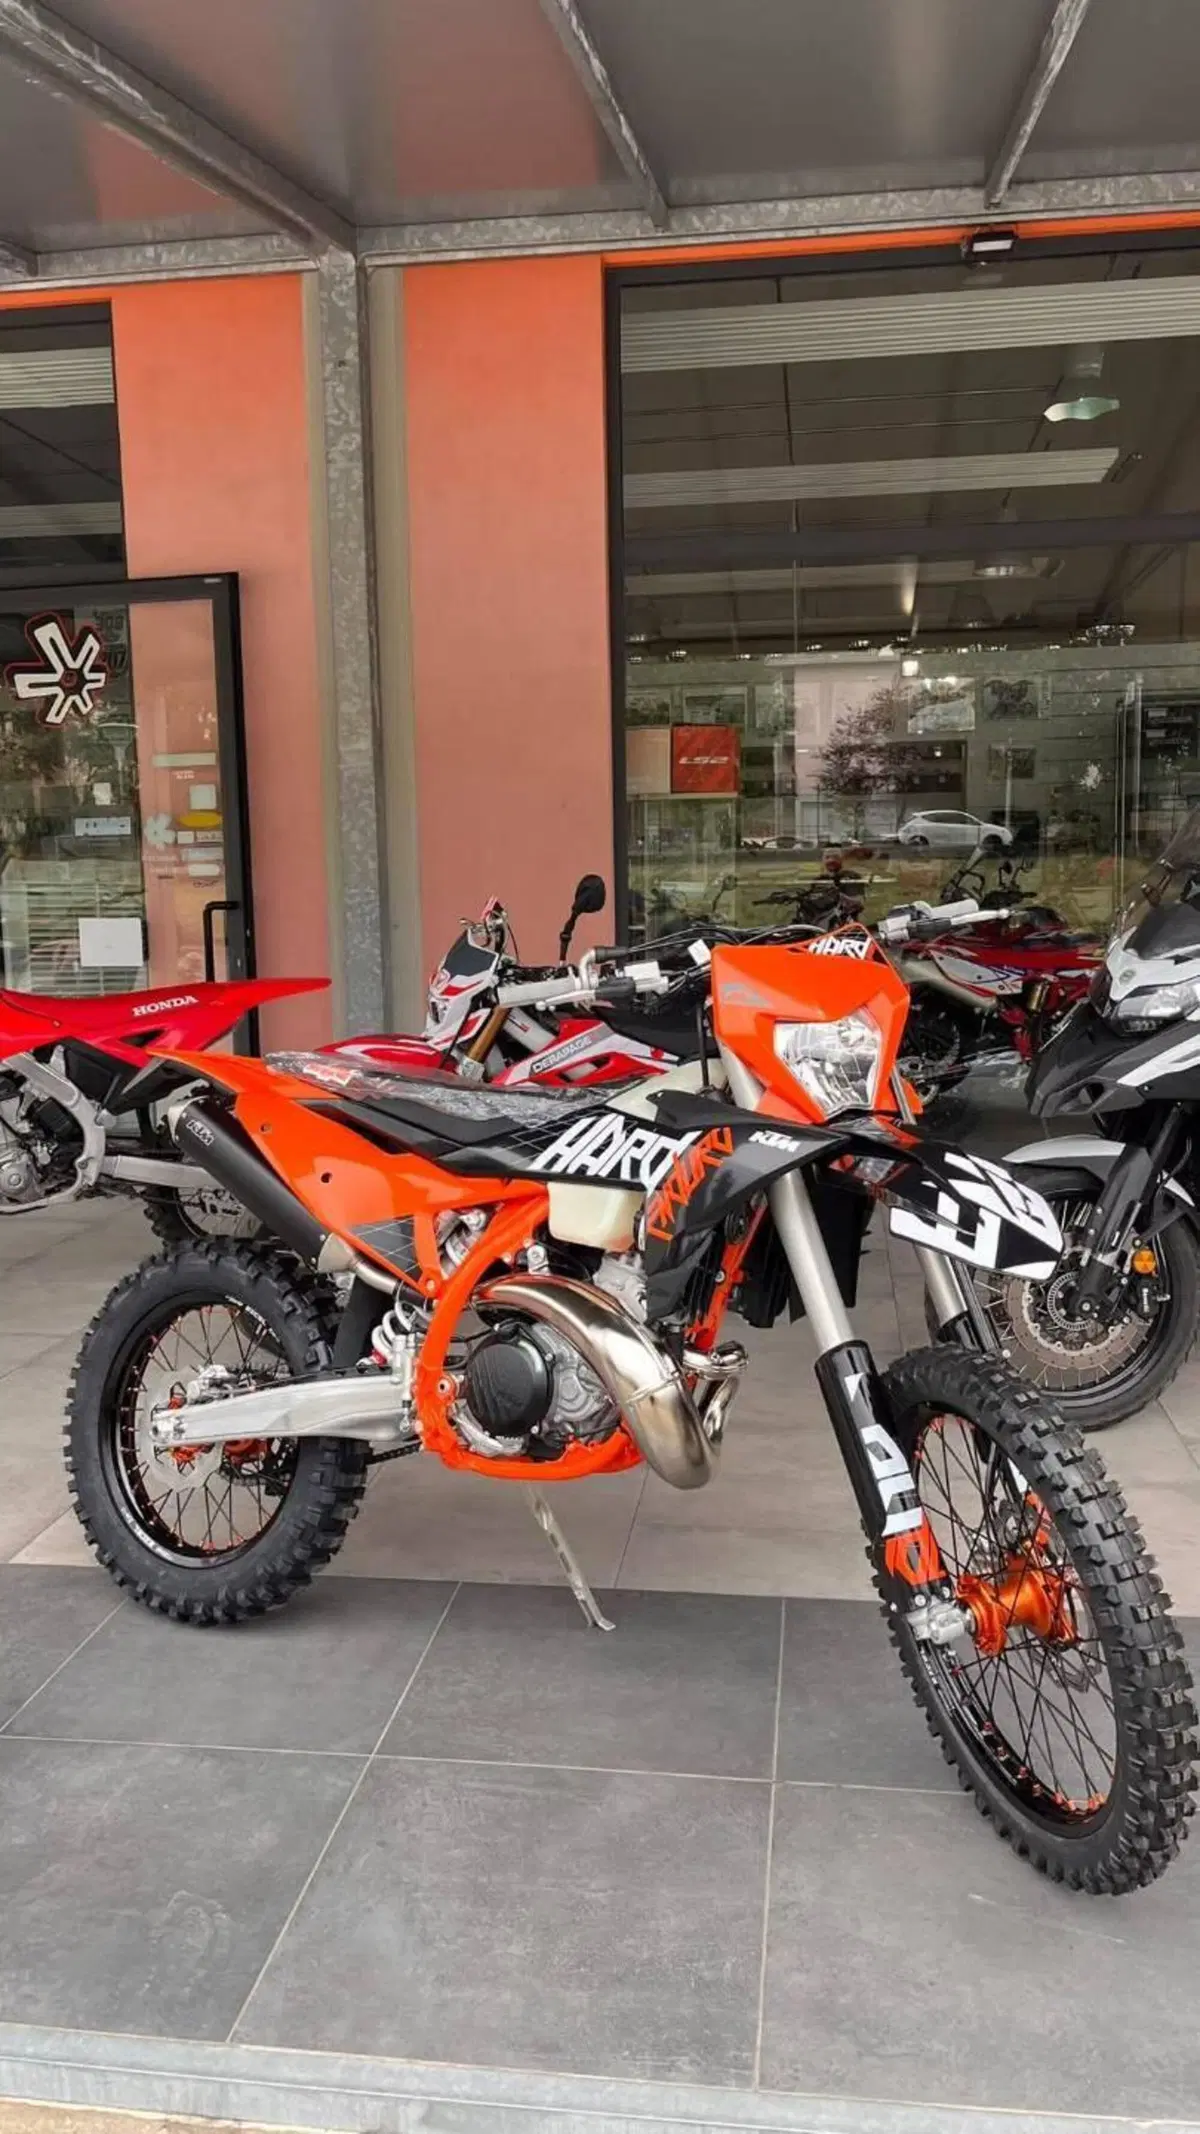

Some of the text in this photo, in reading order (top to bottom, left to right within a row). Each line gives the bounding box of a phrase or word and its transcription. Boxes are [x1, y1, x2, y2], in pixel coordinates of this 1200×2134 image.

[678, 756, 729, 765] LS2
[808, 937, 872, 960] HARD
[132, 994, 199, 1017] HONDA
[532, 1034, 593, 1074] DERAPAGE
[749, 1129, 800, 1154] KTM
[531, 1113, 702, 1196] HARD
